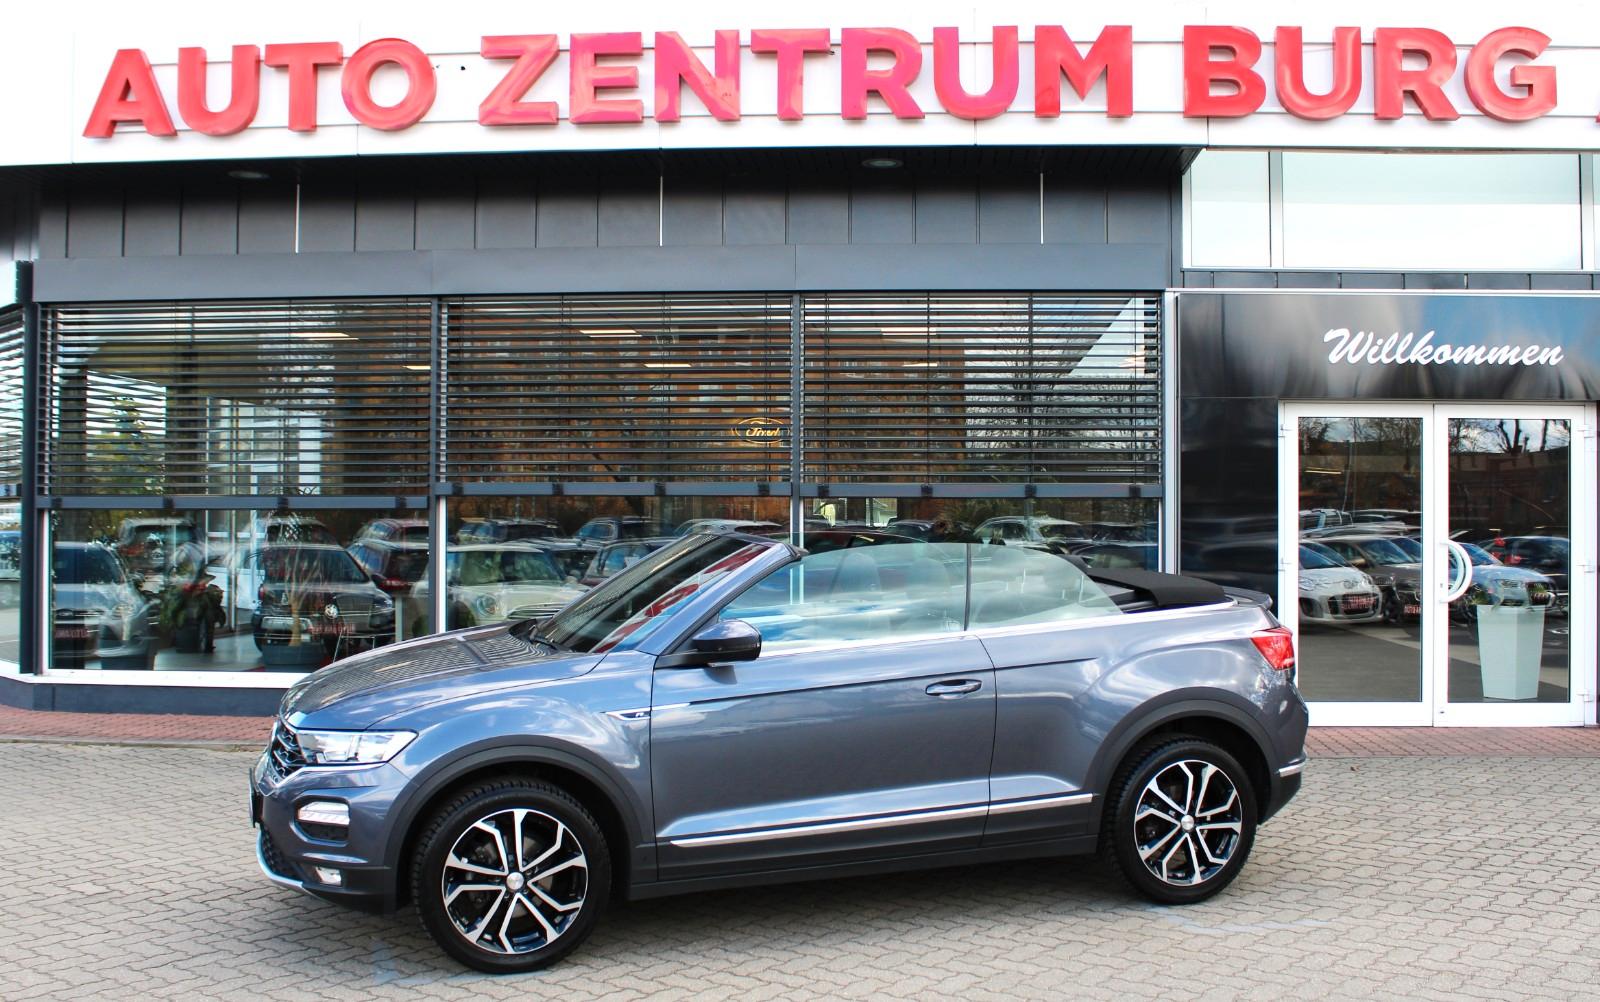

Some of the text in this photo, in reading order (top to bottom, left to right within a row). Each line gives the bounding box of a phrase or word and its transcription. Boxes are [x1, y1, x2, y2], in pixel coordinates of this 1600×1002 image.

[83, 25, 1557, 138] AUTO ZENTRUM BURG
[1323, 327, 1564, 366] Willkommen
